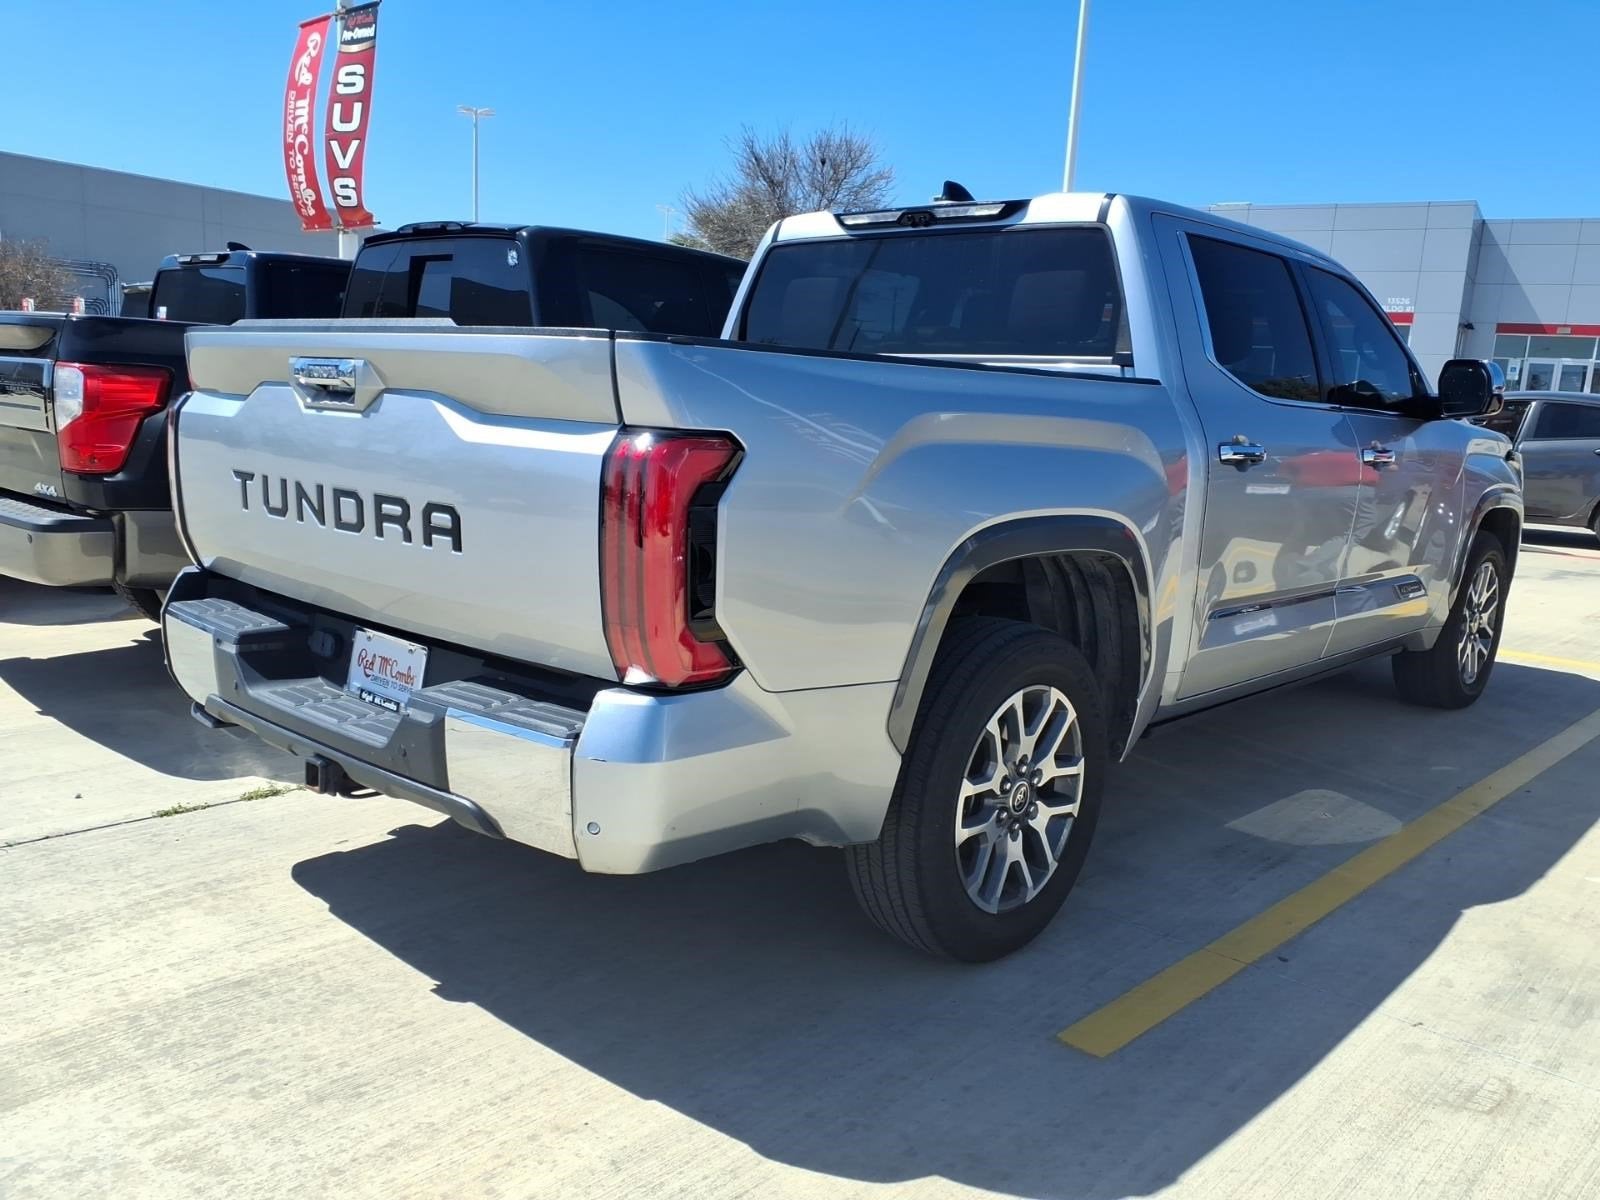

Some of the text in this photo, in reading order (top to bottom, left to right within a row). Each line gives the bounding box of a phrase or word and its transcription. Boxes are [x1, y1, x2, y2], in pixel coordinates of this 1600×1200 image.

[286, 90, 309, 217] DRIVEN TO SERVE
[294, 31, 322, 218] Red McCombs
[329, 64, 365, 208] SUVS
[231, 469, 463, 555] TUNDRA
[357, 648, 415, 686] Red McCombs
[390, 681, 398, 689] TO
